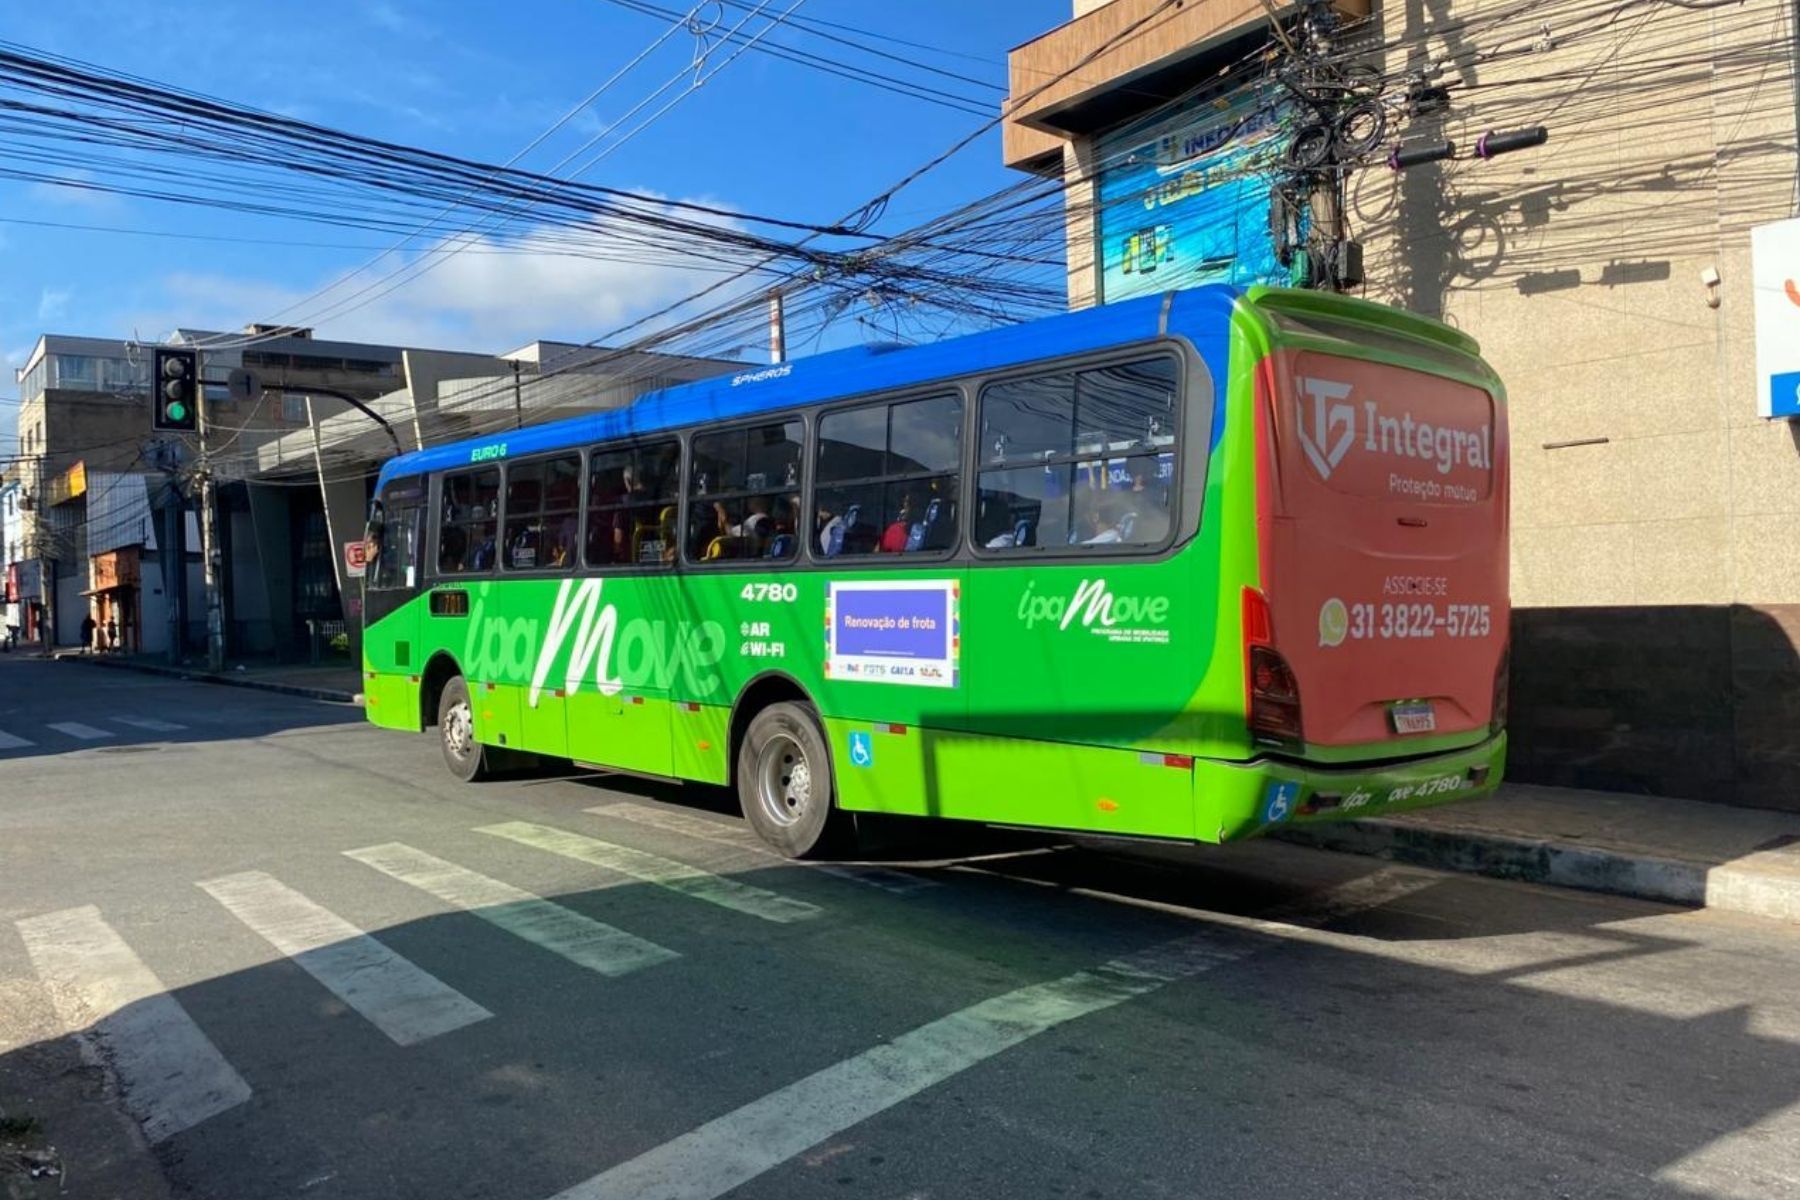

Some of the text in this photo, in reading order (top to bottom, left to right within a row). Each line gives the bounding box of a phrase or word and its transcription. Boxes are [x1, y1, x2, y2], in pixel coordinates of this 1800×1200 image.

[731, 364, 794, 387] SPHEROS
[1365, 401, 1491, 475] Integral
[471, 443, 508, 461] EURO 6
[1389, 473, 1442, 500] Proteção
[740, 583, 798, 602] 4780
[750, 622, 770, 637] AR
[844, 615, 936, 631] Renovação de frota
[1351, 604, 1491, 639] 31 3822-5725
[751, 641, 785, 657] WI-FI
[1415, 776, 1461, 798] 4780
